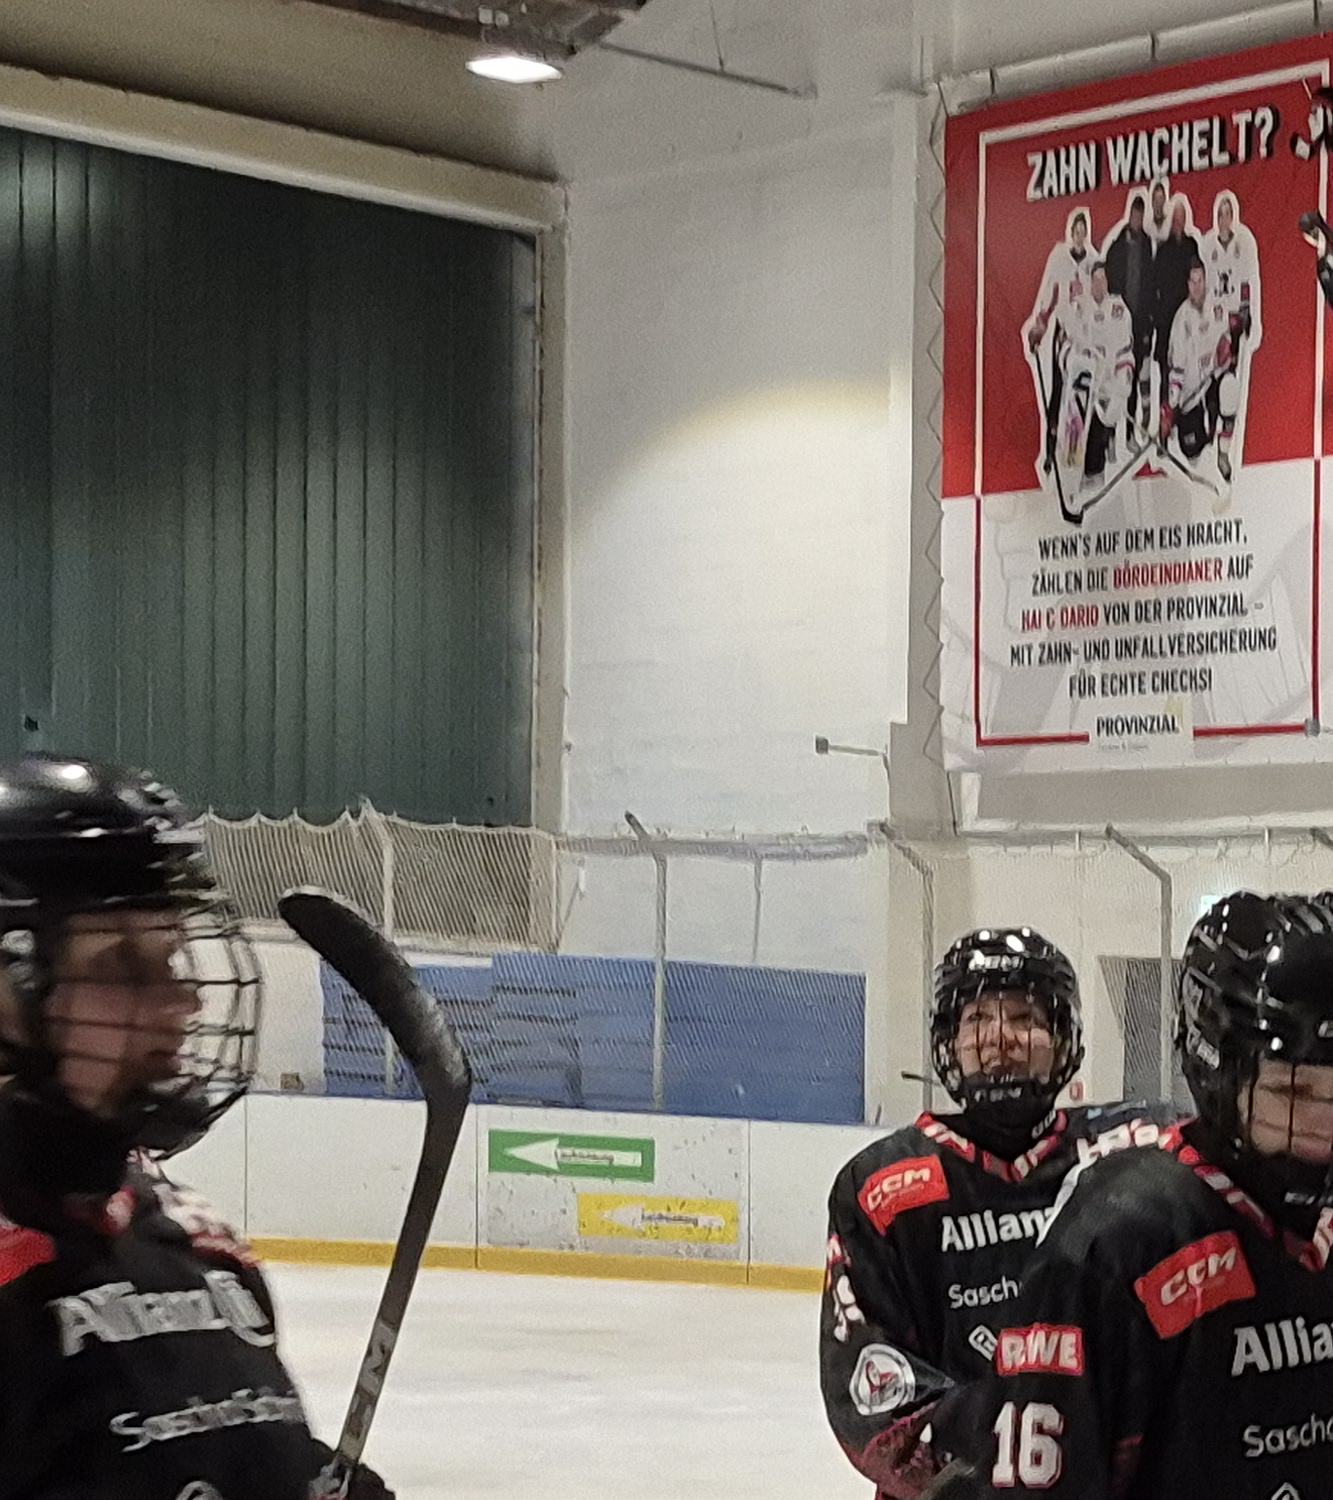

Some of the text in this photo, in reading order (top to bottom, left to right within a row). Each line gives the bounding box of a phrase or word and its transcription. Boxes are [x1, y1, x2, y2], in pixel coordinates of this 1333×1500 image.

[1027, 142, 1099, 202] ZAHN
[1038, 534, 1091, 561] WENN'S
[1095, 530, 1121, 555] AUF
[1124, 527, 1155, 552] DEM
[1158, 523, 1182, 549] EIS
[1031, 567, 1083, 598] ZÄHLEN
[1086, 566, 1109, 591] DIE
[1227, 553, 1254, 580] AUF
[1060, 604, 1099, 629] DARIO
[1103, 600, 1131, 625] VON
[1134, 598, 1163, 624] DER
[1166, 591, 1249, 621] PROVINZIAL
[1010, 626, 1278, 668] MIT ZAHN- UND UNFALLVERSICHERUNG
[1069, 667, 1097, 698] FÜR
[1101, 669, 1147, 696] ECHTE
[1096, 714, 1179, 738] PROVINZIAL
[867, 1167, 932, 1212] CCM
[948, 1275, 1022, 1309] Sasch
[1159, 1242, 1239, 1307] CCM
[991, 1400, 1065, 1489] 16
